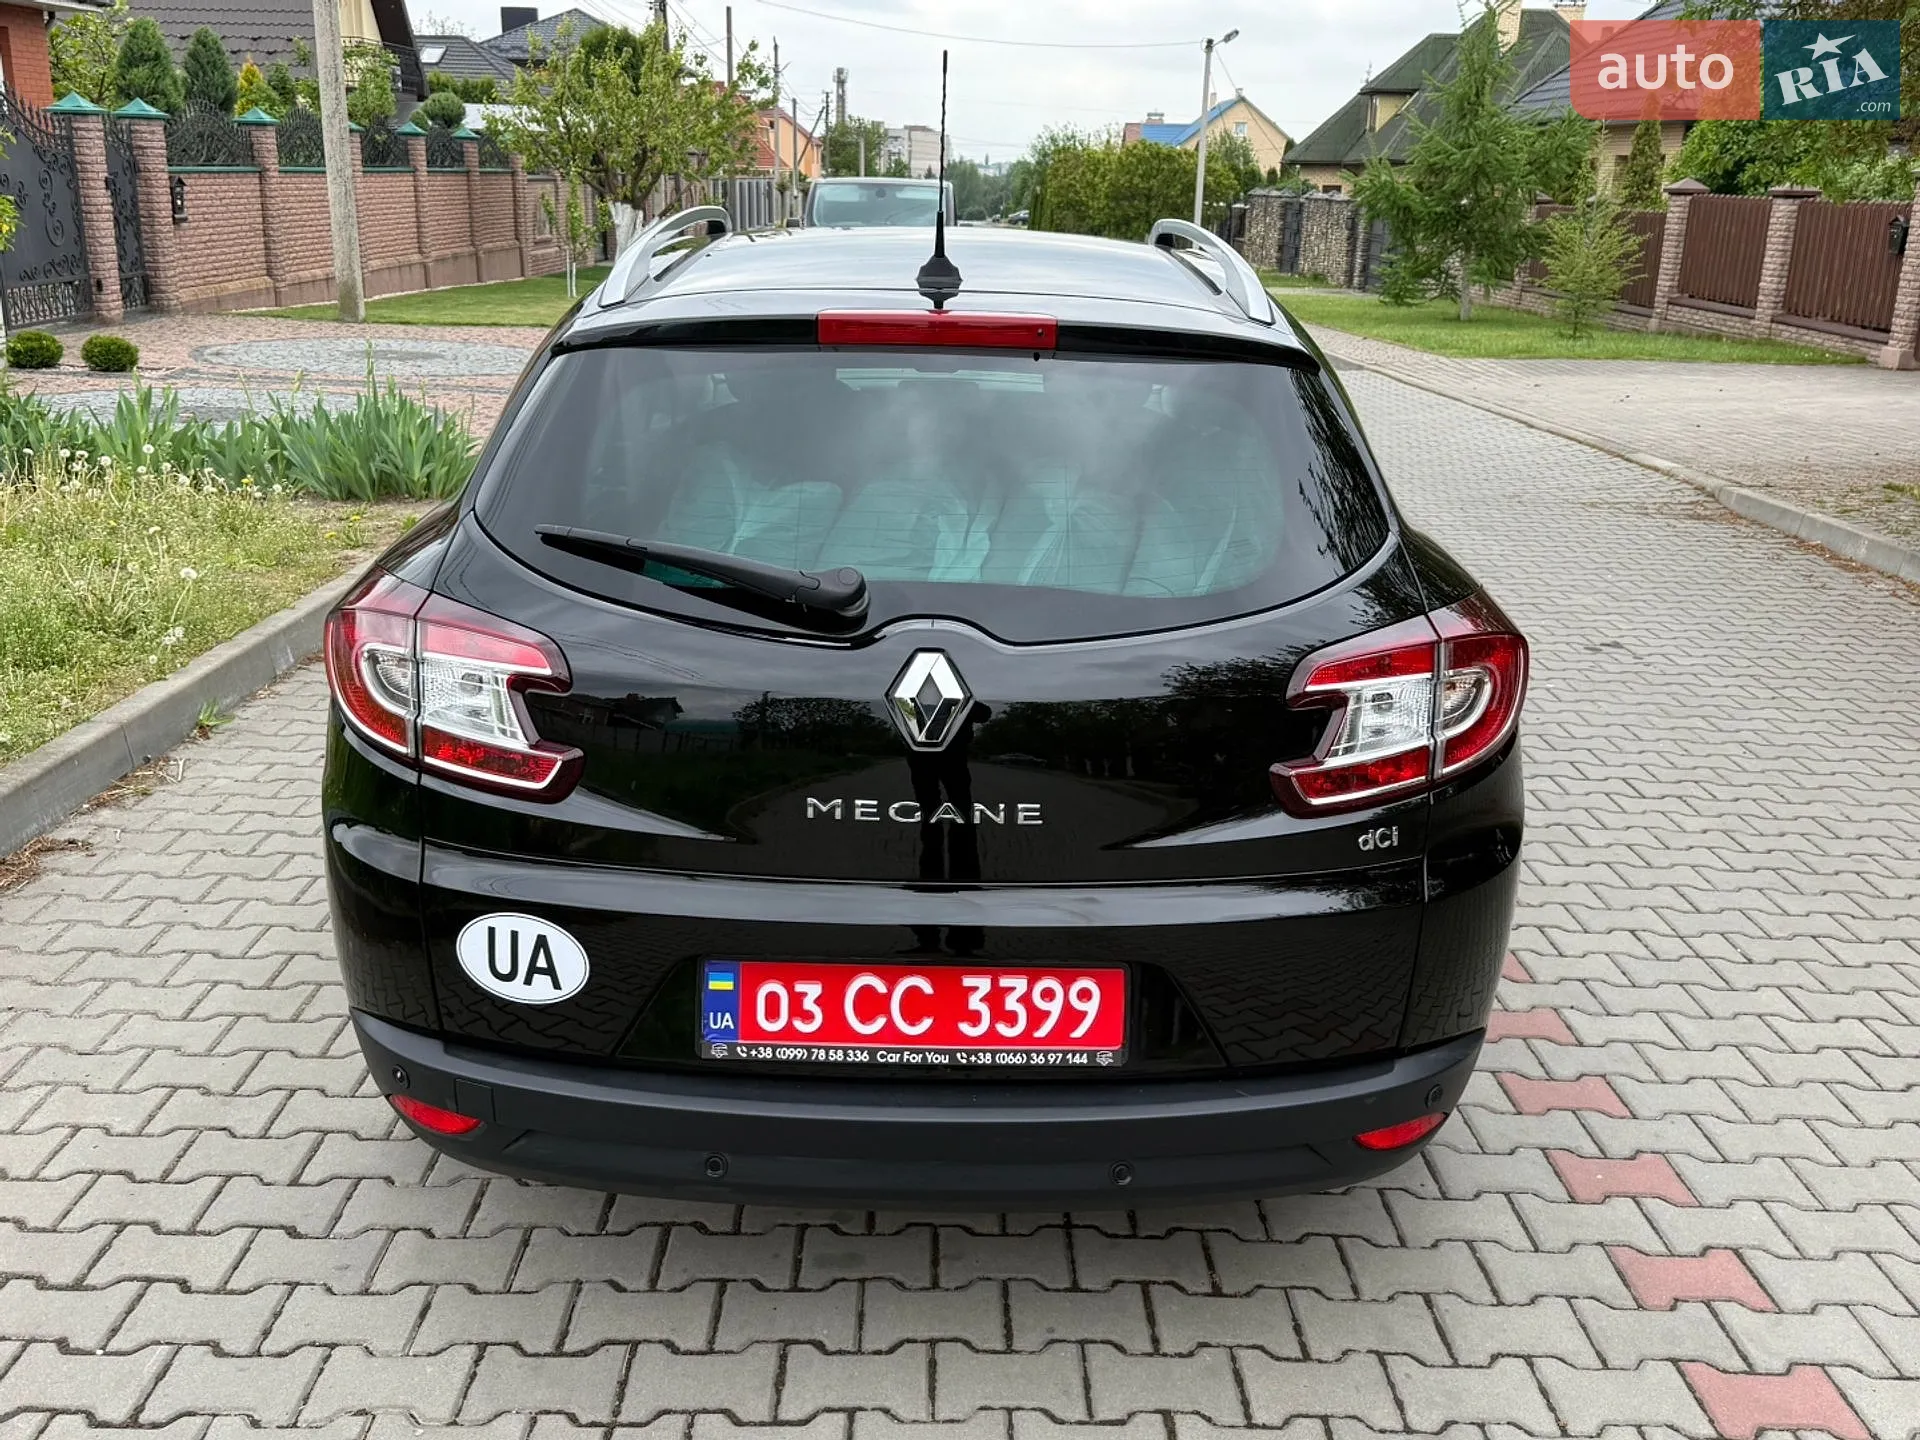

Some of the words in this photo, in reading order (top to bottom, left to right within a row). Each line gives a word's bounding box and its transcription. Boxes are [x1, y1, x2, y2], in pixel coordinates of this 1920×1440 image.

[806, 797, 1043, 825] MEGANE
[1358, 826, 1398, 850] dCi
[488, 926, 562, 990] UA
[756, 979, 823, 1033] 03
[843, 972, 934, 1036] CC
[957, 975, 1101, 1038] 3399
[709, 1012, 734, 1029] UA
[750, 1047, 773, 1059] +38
[776, 1047, 808, 1060] (099)
[811, 1048, 826, 1061] 78
[828, 1048, 844, 1061] 58
[846, 1049, 869, 1061] 336
[877, 1050, 900, 1062] Car
[903, 1051, 923, 1063] For
[925, 1051, 949, 1063] You
[969, 1053, 992, 1064] +38
[995, 1052, 1026, 1065] (066)
[1031, 1053, 1046, 1064] 36
[1048, 1053, 1063, 1064] 97
[1066, 1053, 1088, 1064] 144
